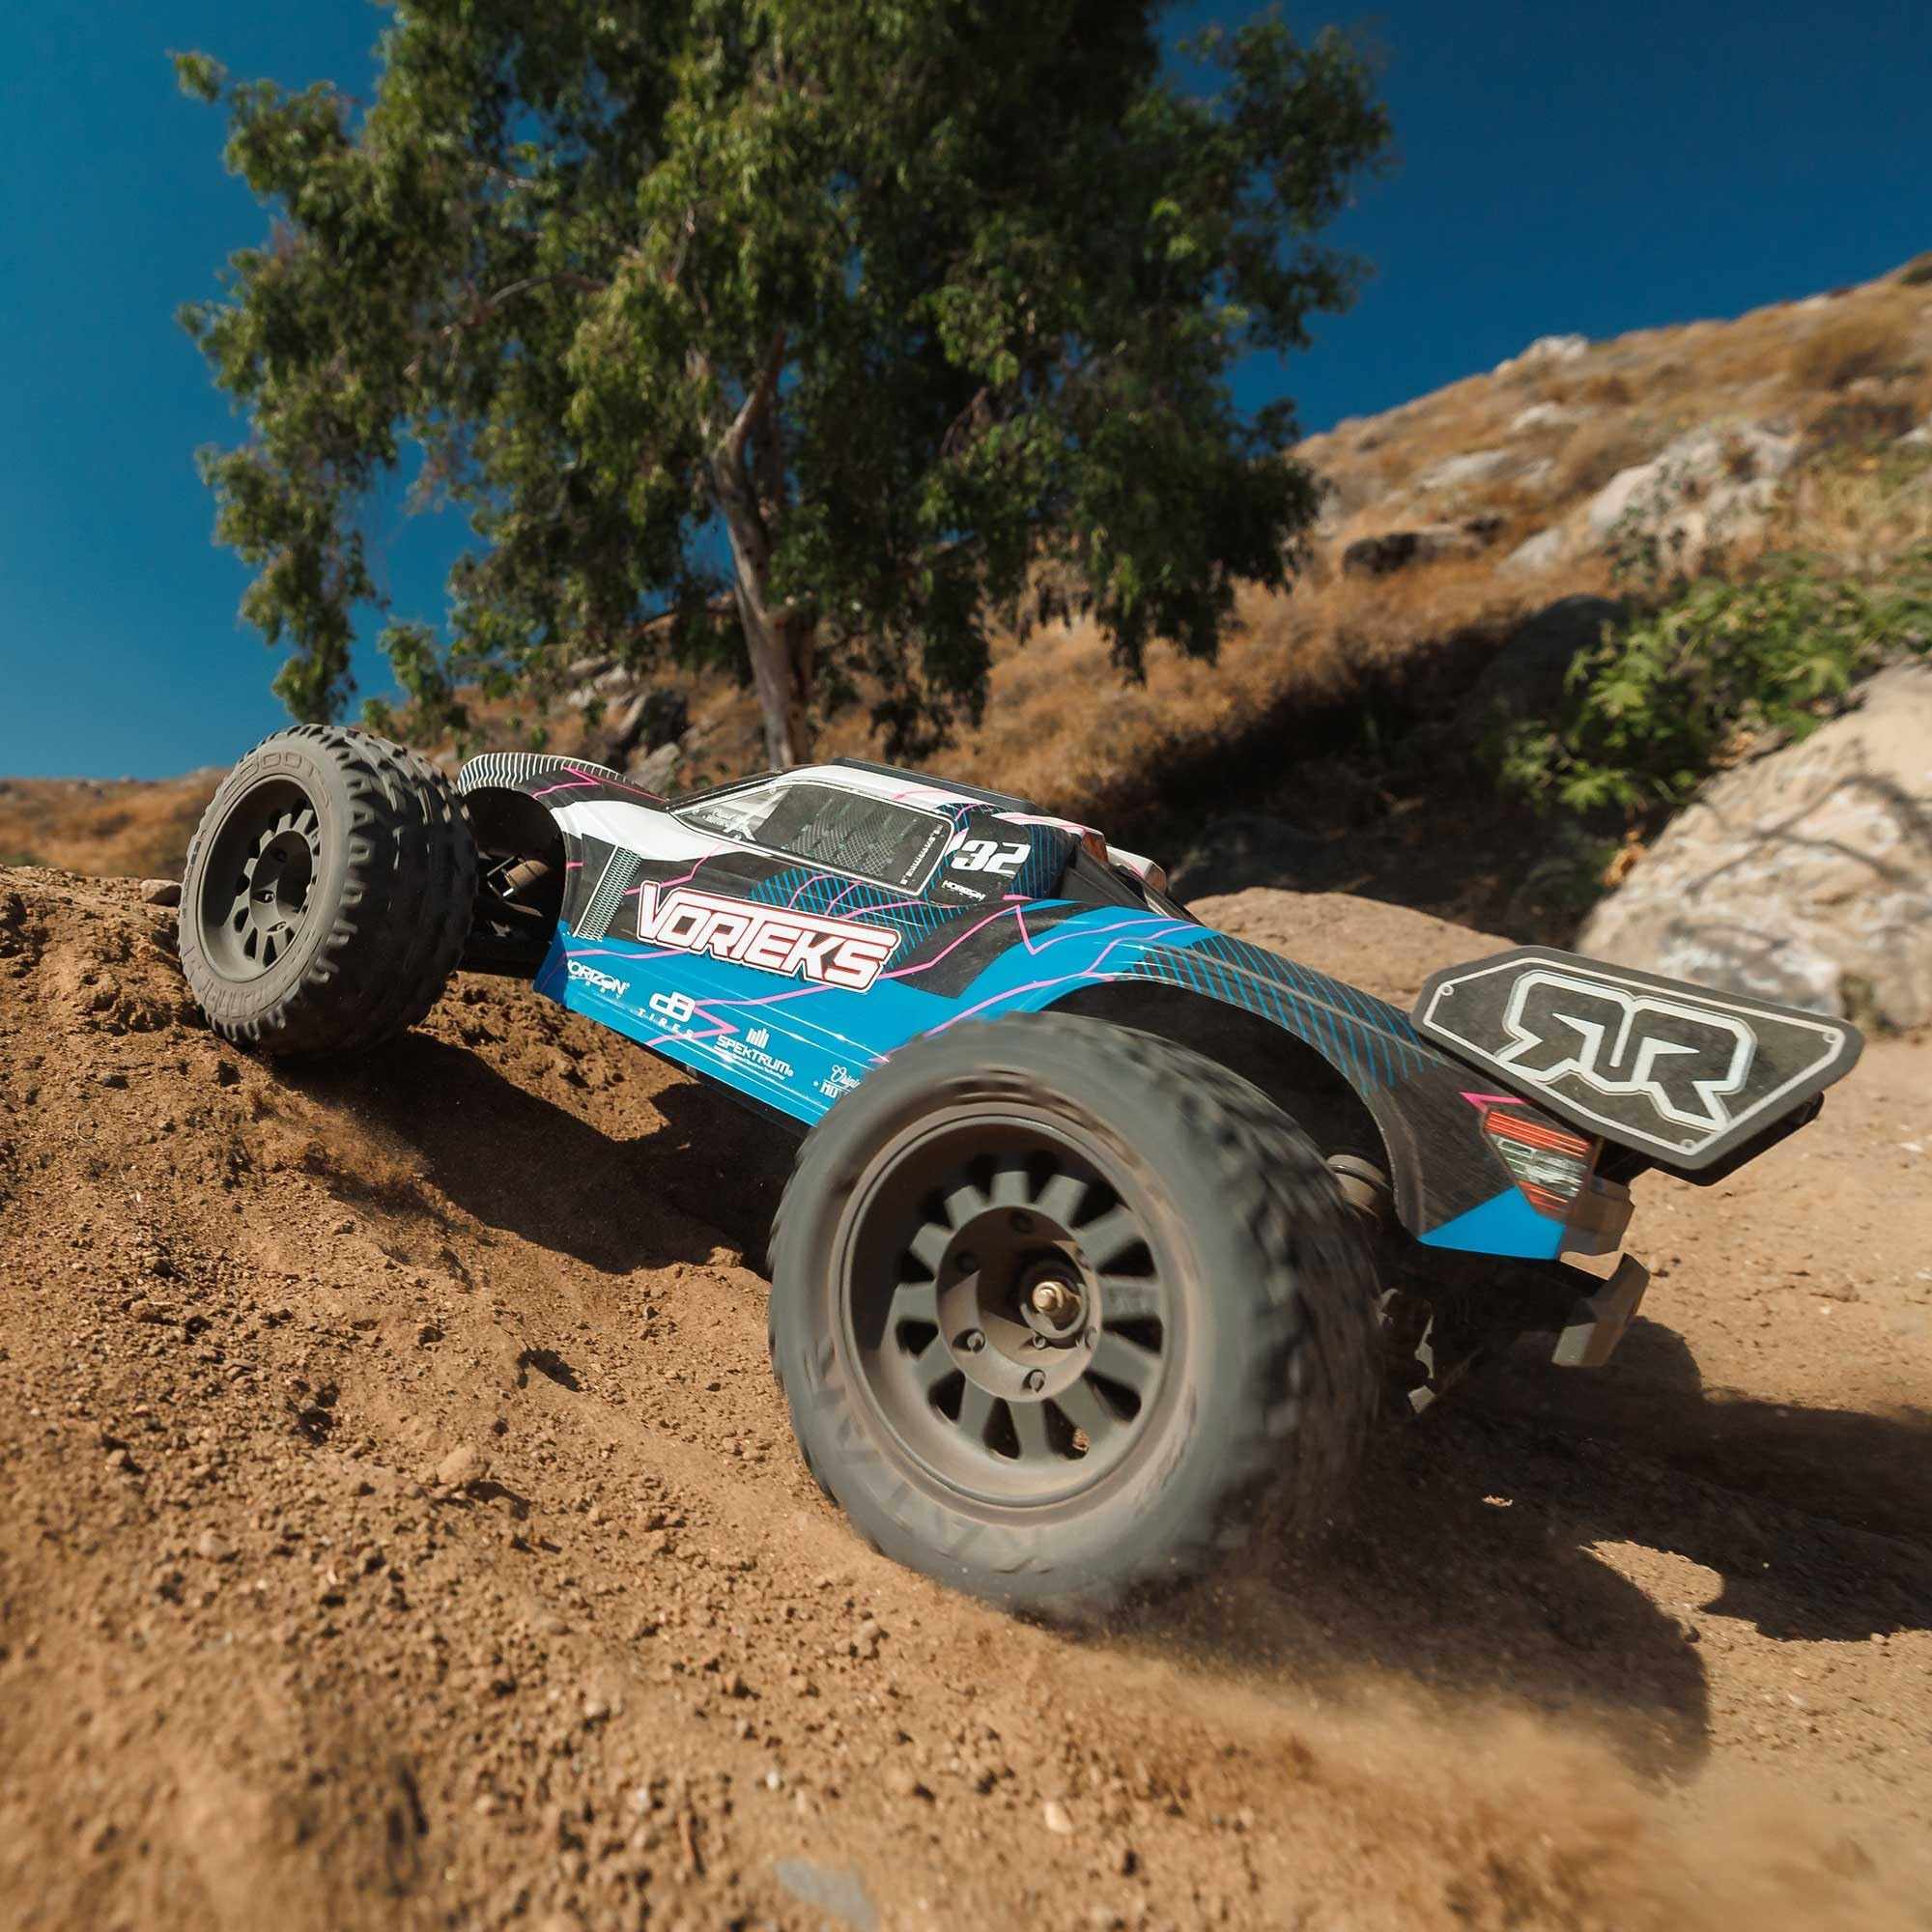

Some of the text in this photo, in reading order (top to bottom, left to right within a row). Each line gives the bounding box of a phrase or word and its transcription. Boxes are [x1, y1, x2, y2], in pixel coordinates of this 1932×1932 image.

[951, 839, 1031, 879] 32
[638, 880, 901, 993] VORTEKS
[638, 1008, 694, 1038] TIRES
[716, 1035, 791, 1076] SPEKTRUM
